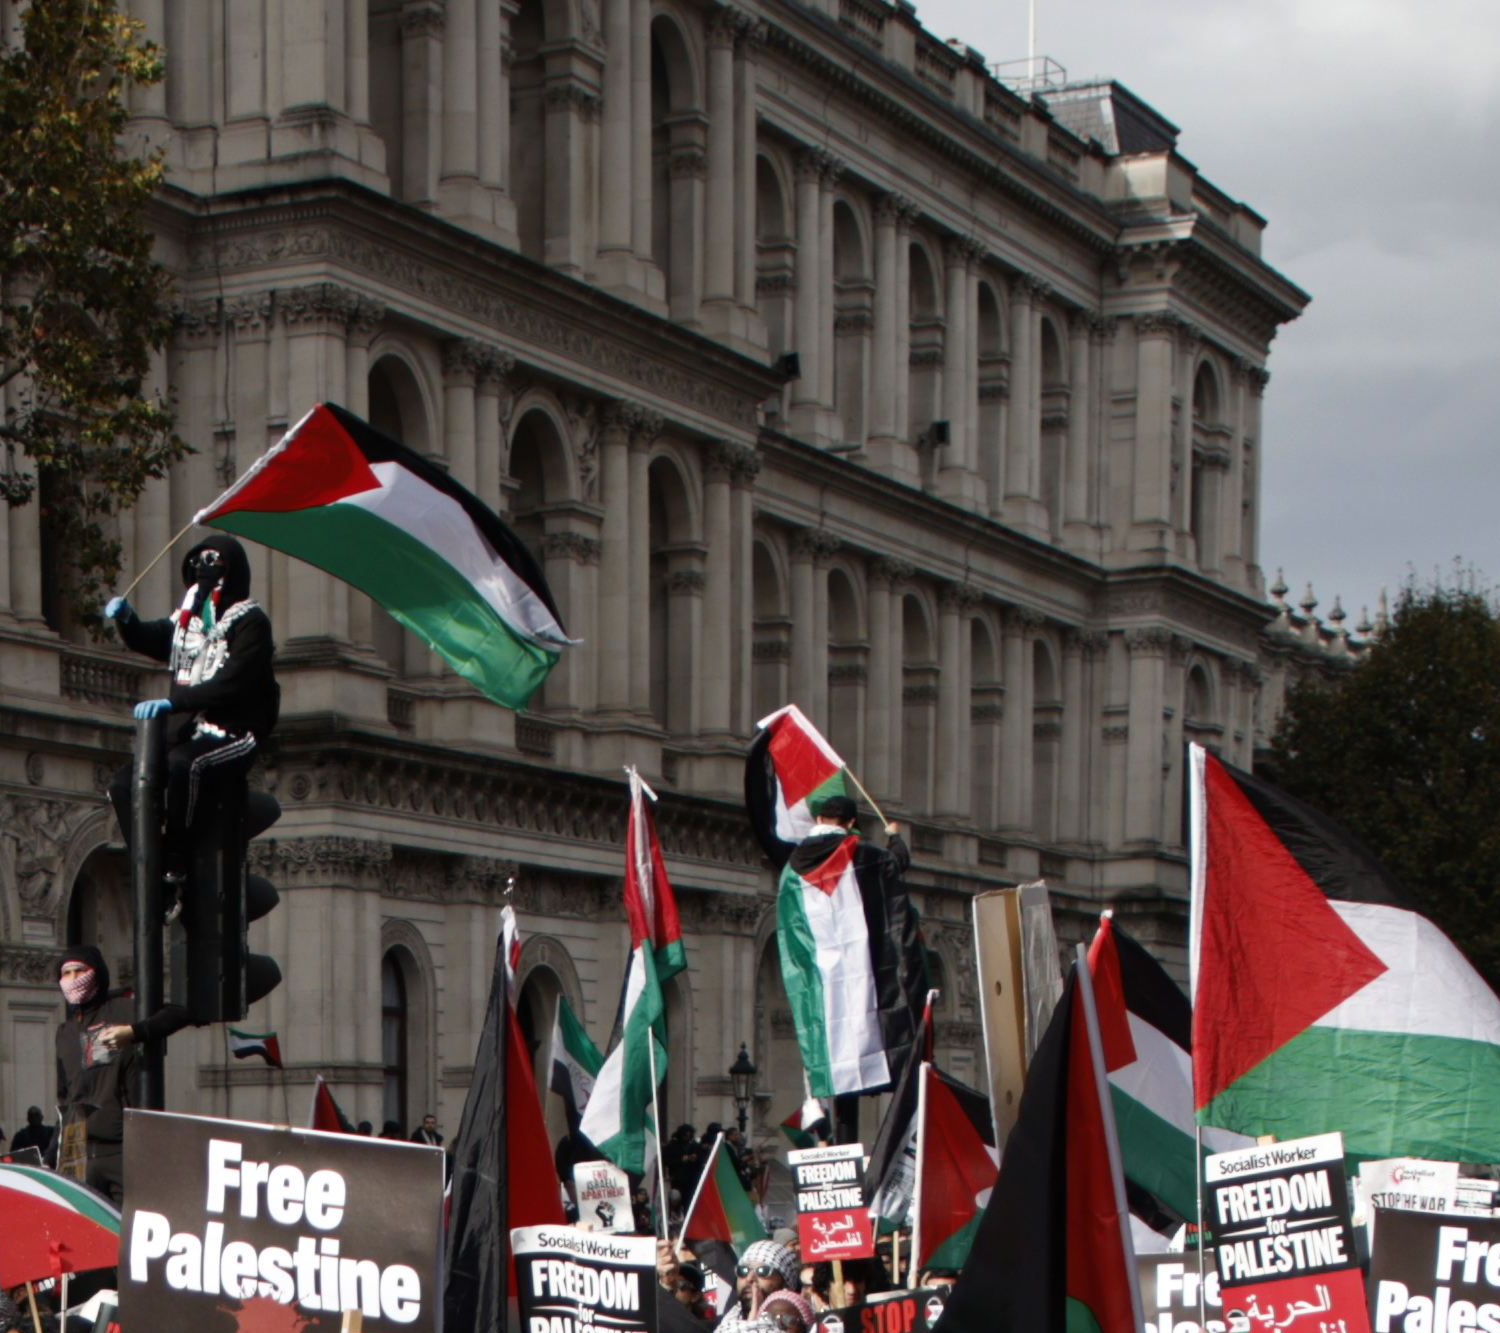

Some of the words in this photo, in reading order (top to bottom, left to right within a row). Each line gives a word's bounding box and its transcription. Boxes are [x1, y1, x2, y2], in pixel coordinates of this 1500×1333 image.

[592, 1168, 608, 1180] END
[796, 1160, 858, 1186] FREEDOM
[1219, 1158, 1272, 1176] Socialist
[1272, 1147, 1317, 1165] Worker
[206, 1138, 347, 1231] Free
[581, 1187, 625, 1202] APARTHEID
[586, 1177, 618, 1191] ISRAELI
[1216, 1169, 1332, 1225] FREEDOM
[797, 1186, 864, 1213] PALESTINE
[1420, 1196, 1446, 1212] WAR
[1266, 1216, 1288, 1236] for
[537, 1232, 584, 1254] Socialist
[584, 1240, 631, 1260] Worker
[1219, 1226, 1348, 1281] PALESTINE
[129, 1209, 422, 1324] Palestine
[530, 1259, 641, 1312] FREEDOM
[577, 1302, 596, 1323] for
[1246, 1284, 1331, 1328] الحرية
